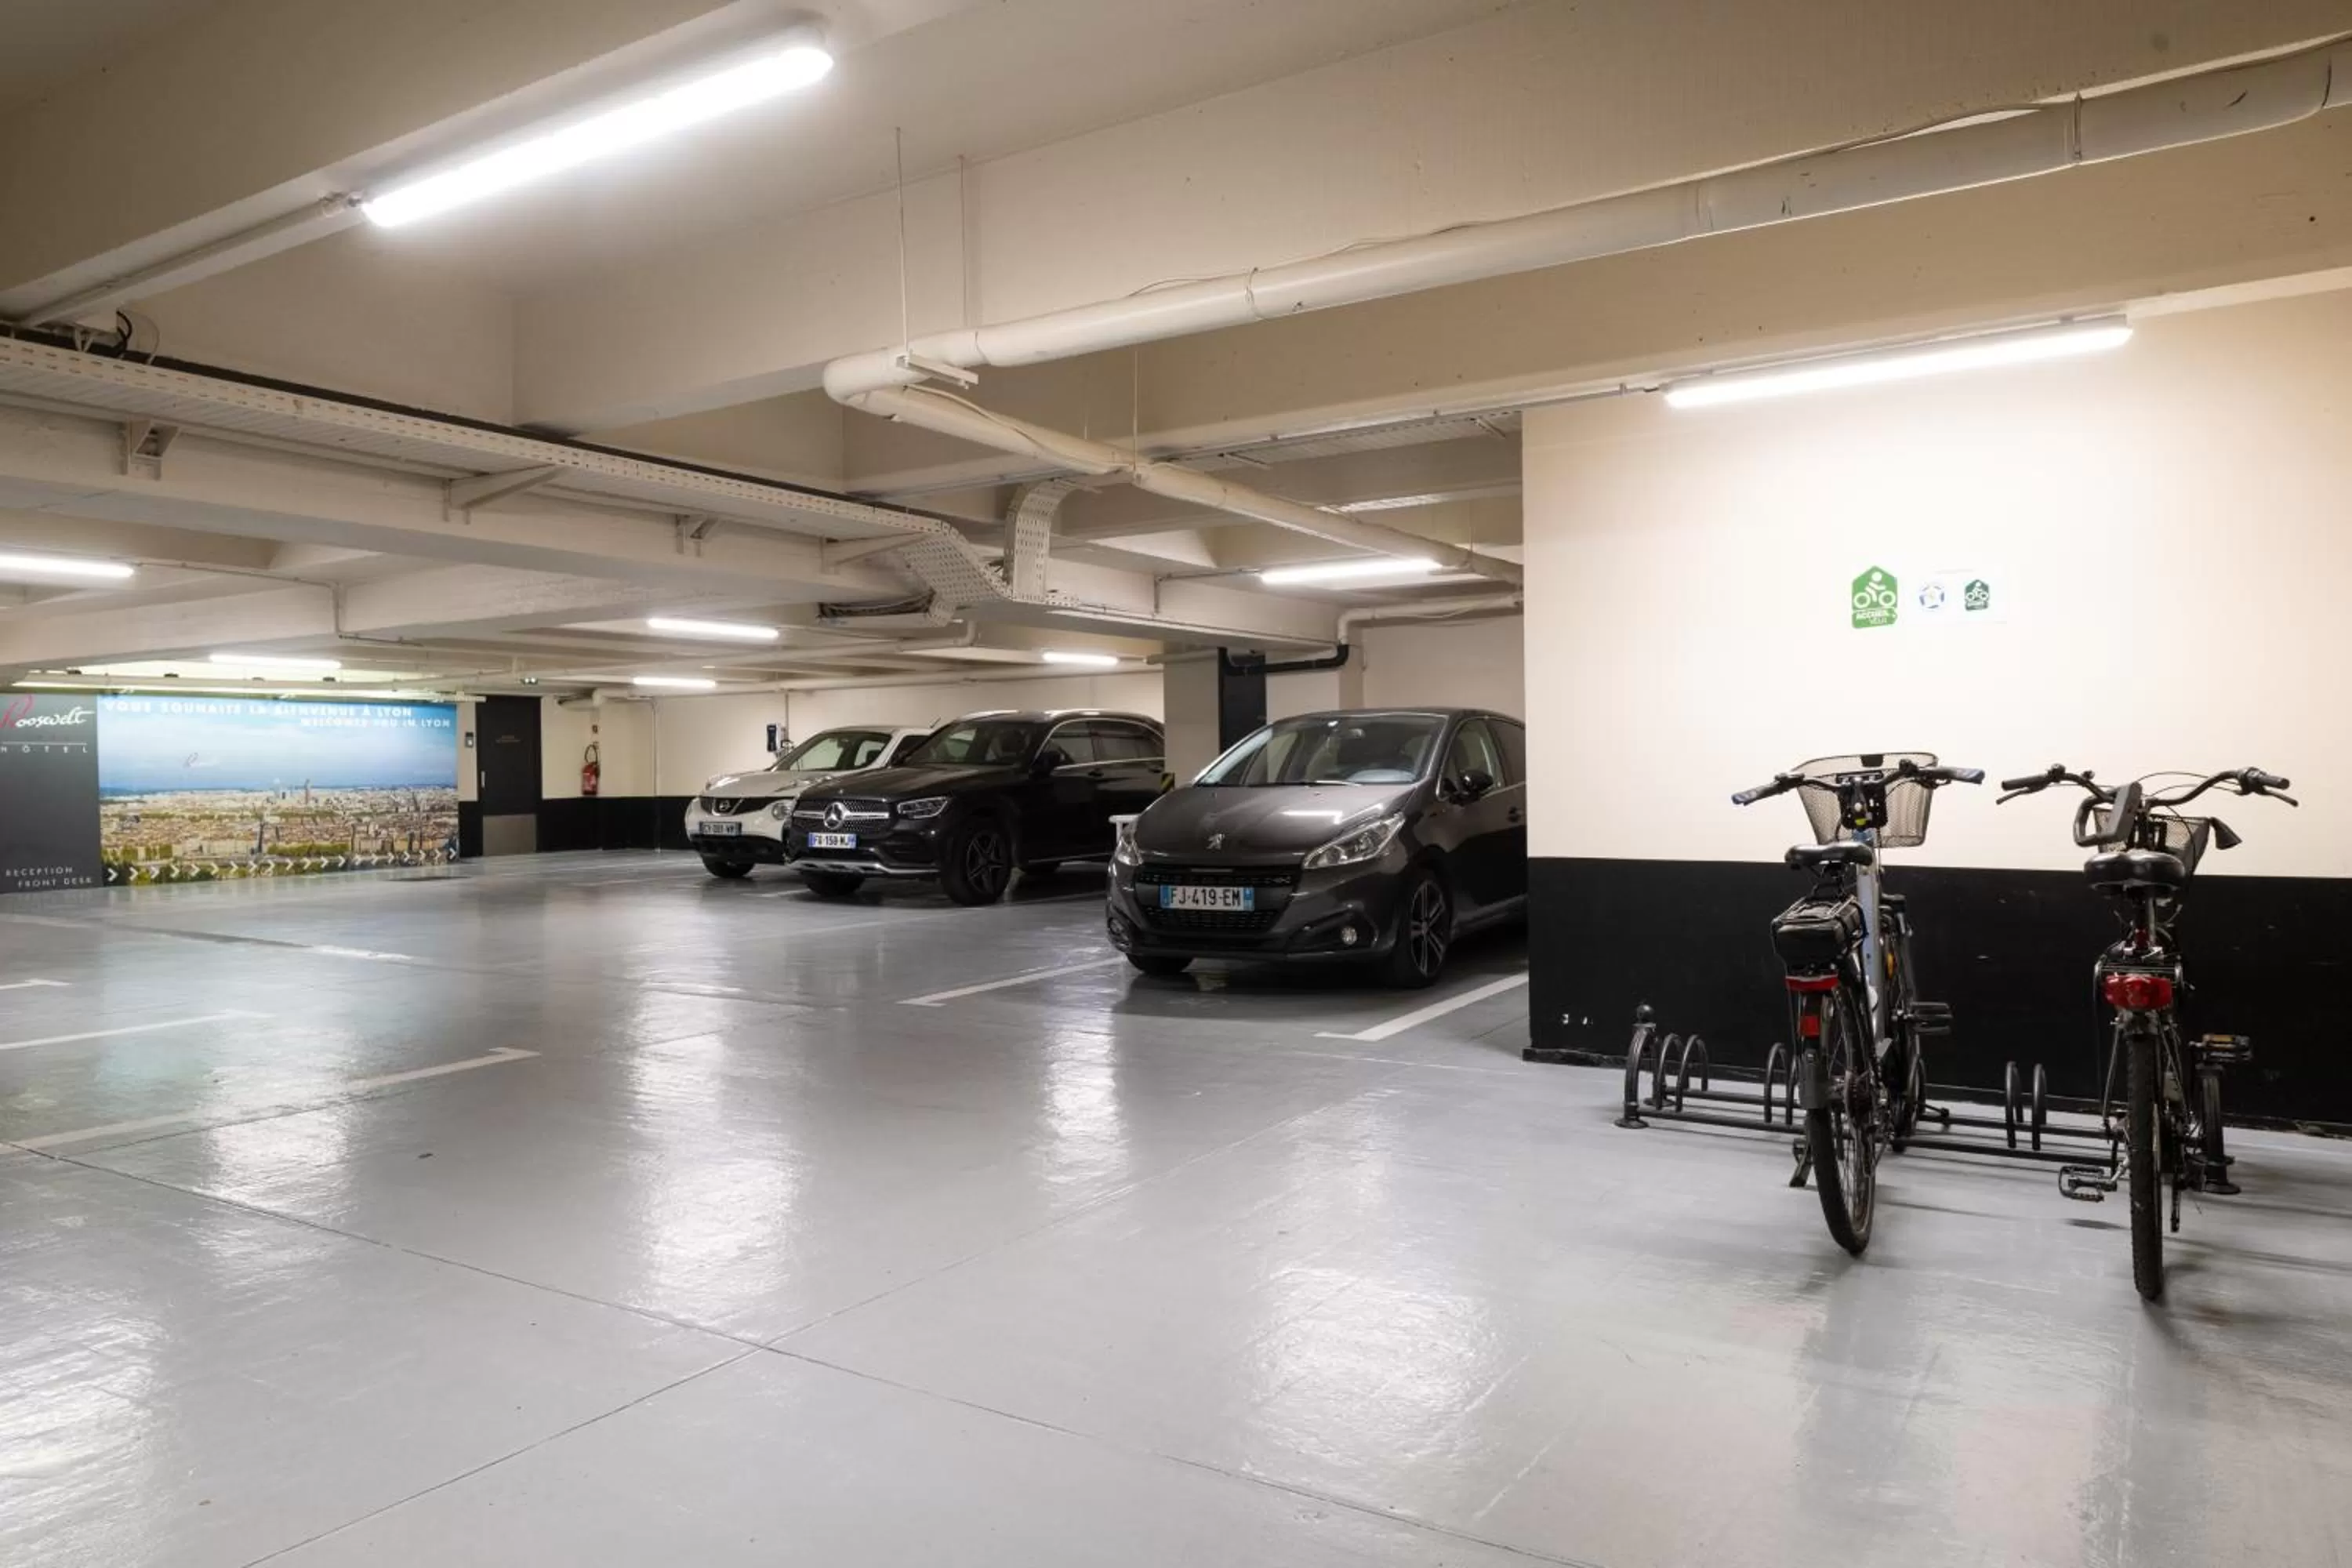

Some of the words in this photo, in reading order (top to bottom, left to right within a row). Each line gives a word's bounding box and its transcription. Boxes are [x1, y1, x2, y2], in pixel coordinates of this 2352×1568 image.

[377, 706, 412, 717] LYON
[421, 719, 451, 728] LYON
[18, 878, 56, 888] FRONT
[1171, 887, 1240, 906] FJ-419-EM
